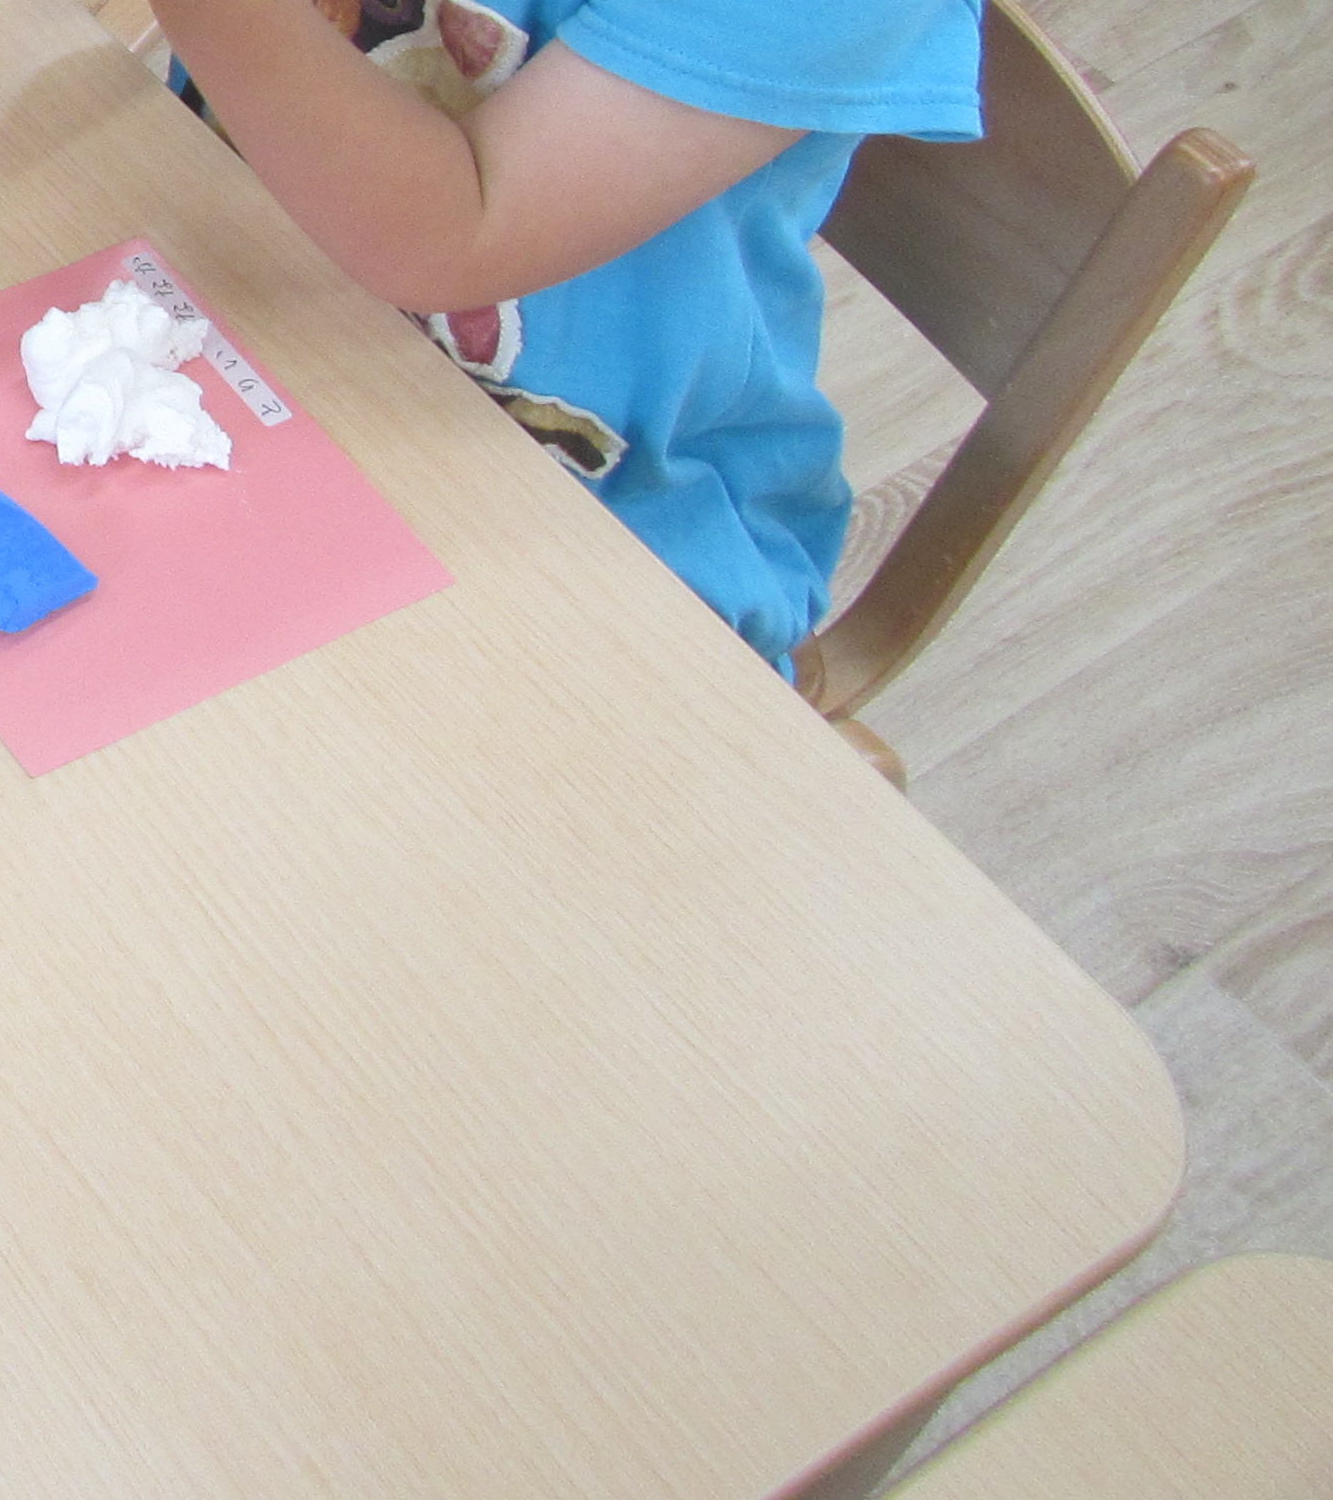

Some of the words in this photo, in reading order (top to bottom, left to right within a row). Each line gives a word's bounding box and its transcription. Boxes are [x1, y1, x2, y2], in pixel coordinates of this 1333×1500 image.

[132, 256, 196, 322] ななか
[214, 349, 282, 416] とりい
